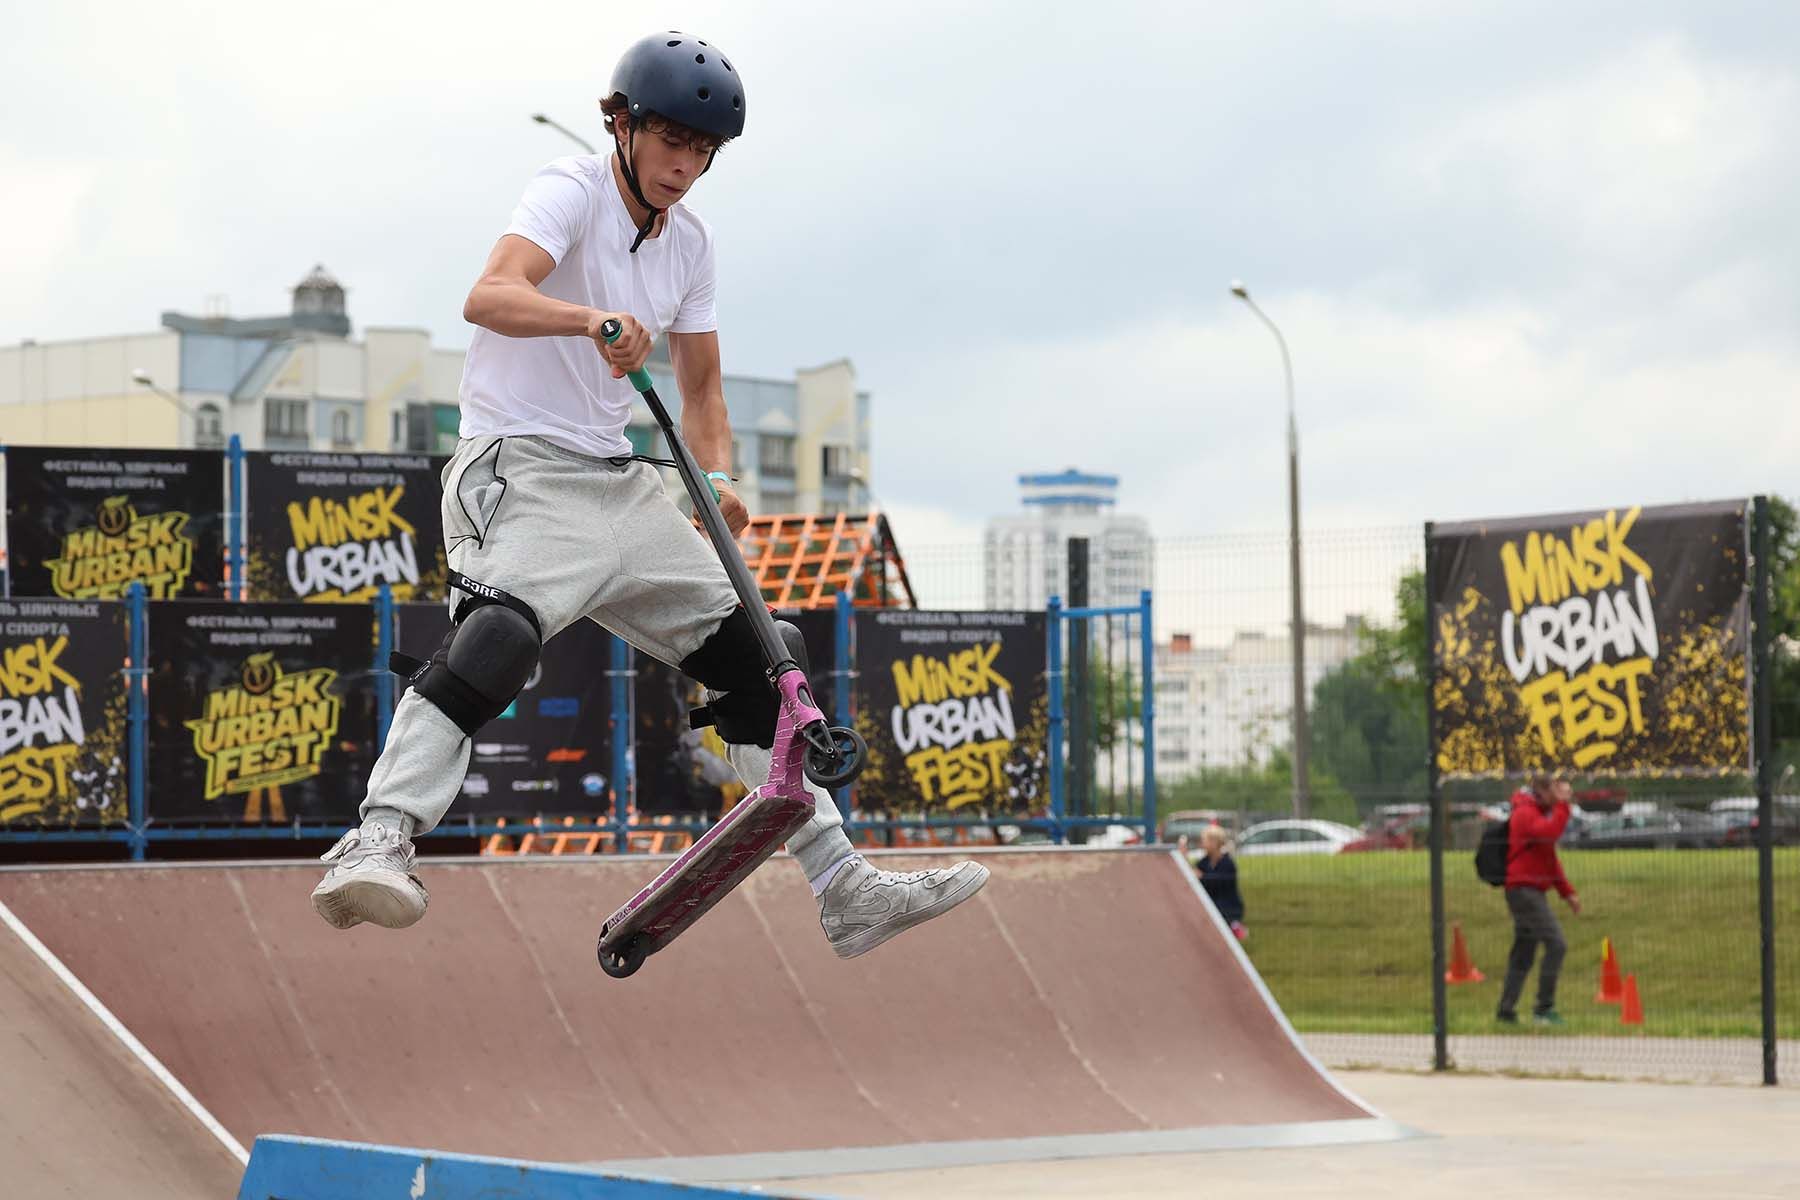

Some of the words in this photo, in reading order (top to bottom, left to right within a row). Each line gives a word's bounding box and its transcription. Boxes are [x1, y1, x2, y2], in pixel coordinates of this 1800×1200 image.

[59, 541, 182, 591] URBAN
[286, 530, 420, 597] URBAN
[1501, 573, 1659, 683] URBAN
[0, 633, 81, 697] NSK
[0, 686, 85, 755] BAN
[202, 700, 330, 752] URBAN
[891, 687, 1017, 754] URBAN
[1520, 656, 1652, 758] FEST
[0, 743, 78, 802] EST
[214, 731, 319, 787] FEST
[906, 739, 1010, 801] FEST
